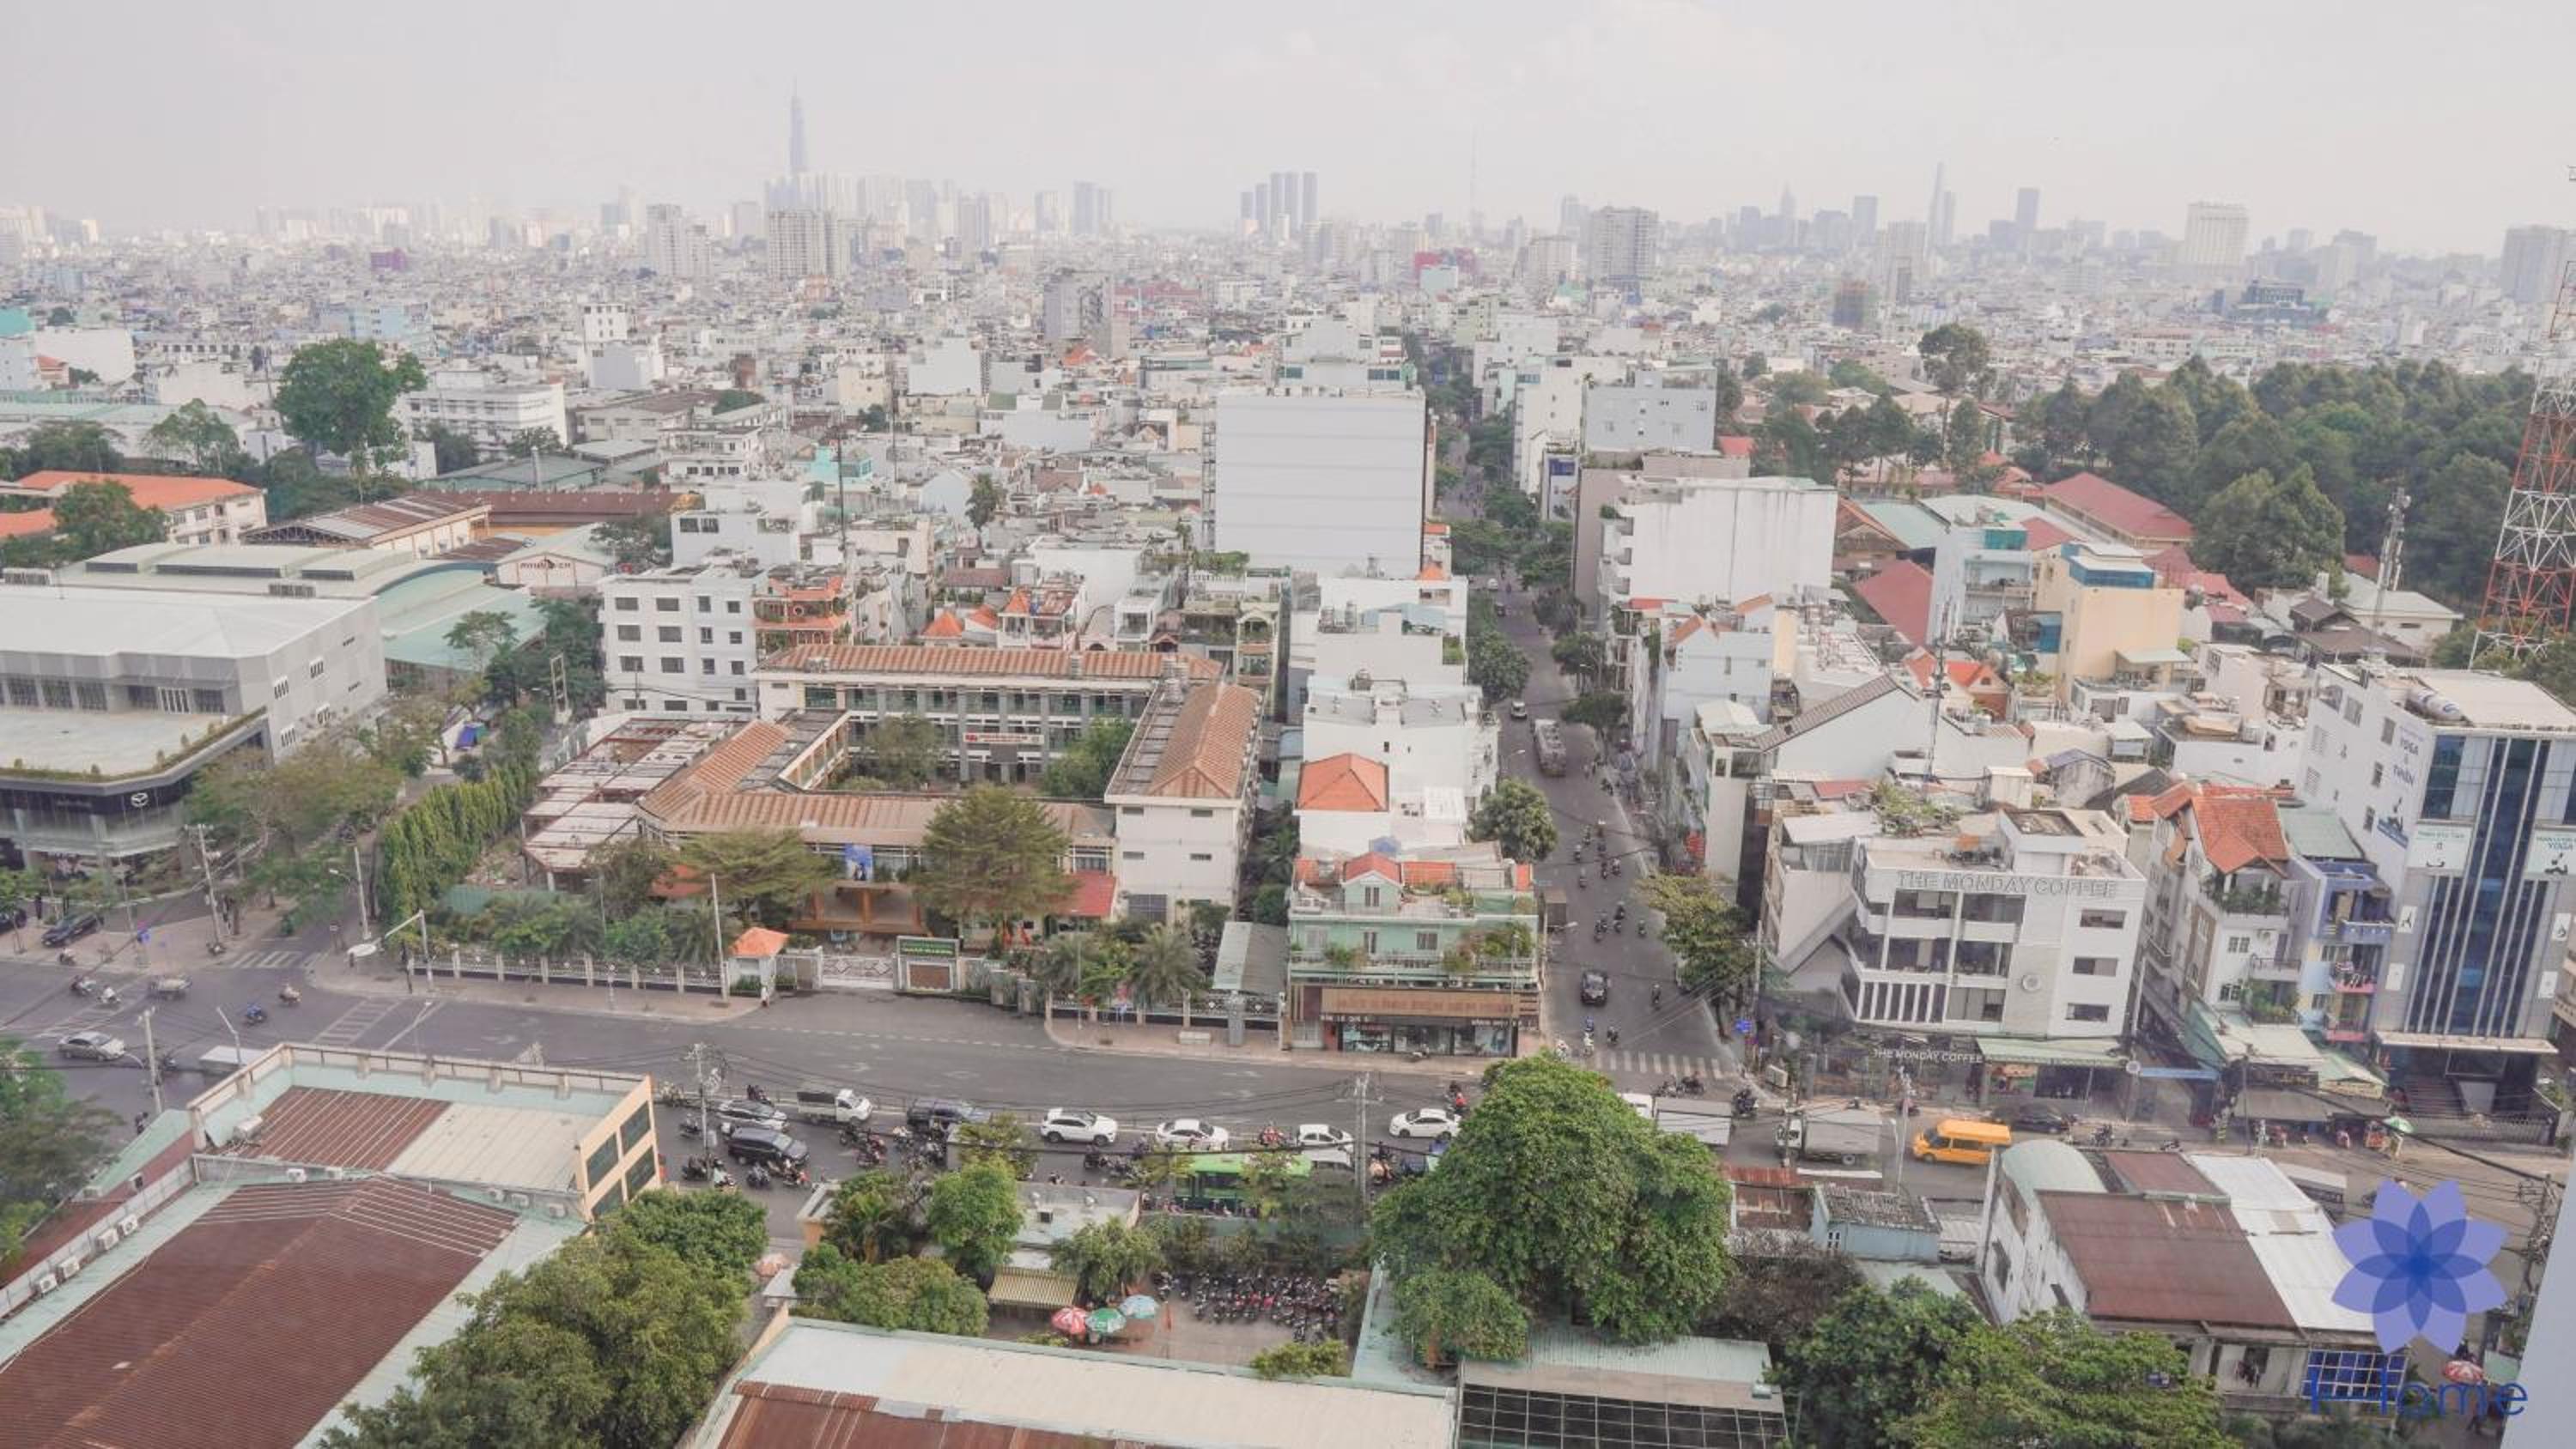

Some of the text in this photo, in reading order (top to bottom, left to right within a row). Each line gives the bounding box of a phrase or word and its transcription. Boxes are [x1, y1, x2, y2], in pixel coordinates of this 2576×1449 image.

[1897, 871, 2117, 898] THE MONDAY COFFEE
[1872, 1047, 1984, 1064] THE MONDAY COFFEE
